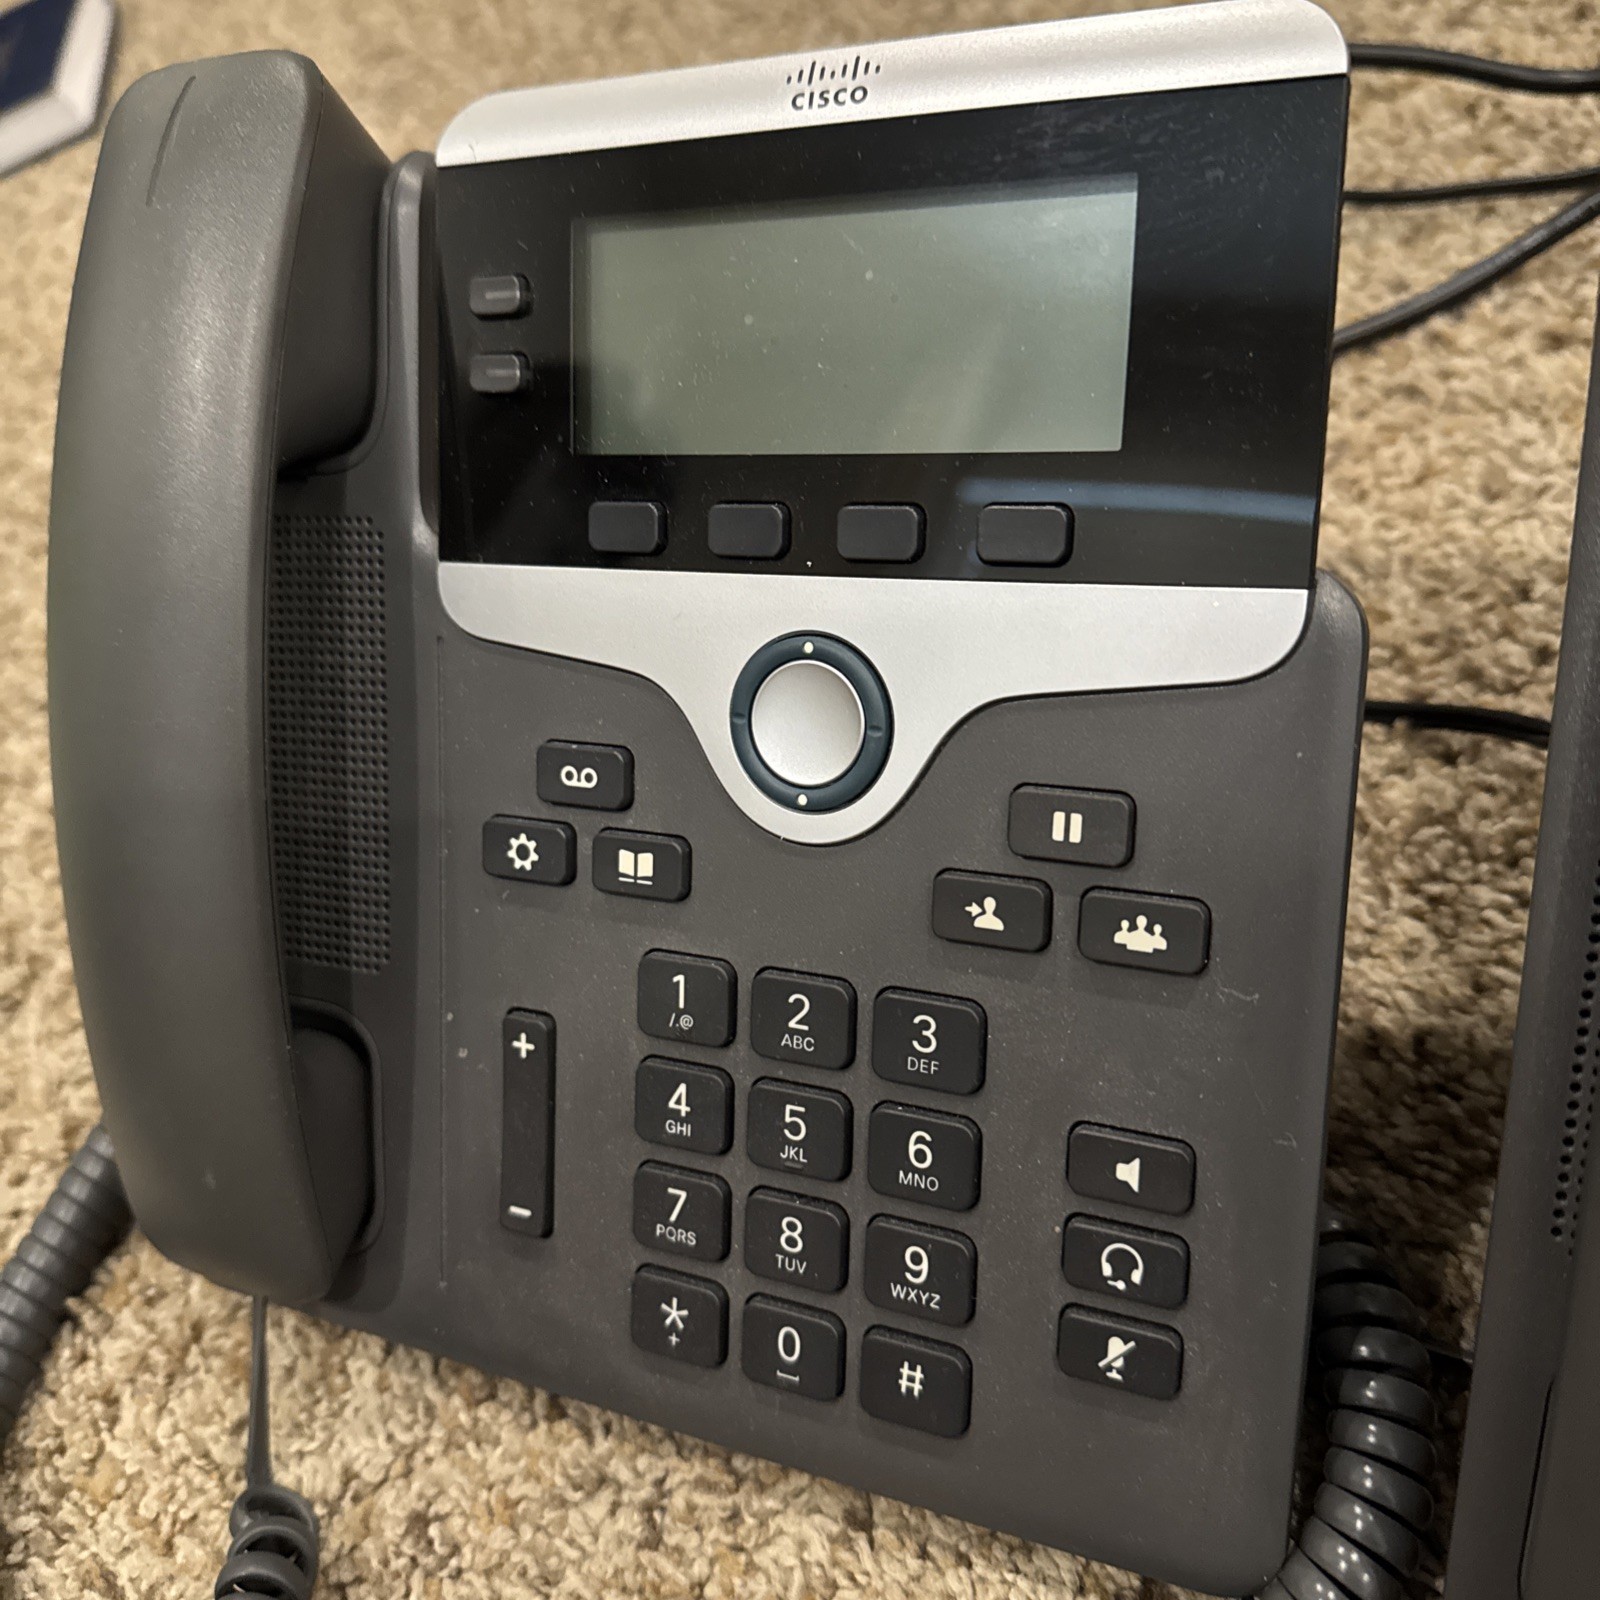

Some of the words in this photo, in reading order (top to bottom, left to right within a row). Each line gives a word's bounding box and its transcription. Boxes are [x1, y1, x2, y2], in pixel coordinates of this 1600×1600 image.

[791, 85, 868, 111] CISCO
[673, 974, 686, 1010] 1
[787, 993, 811, 1031] 2
[780, 1033, 815, 1052] ABC
[911, 1014, 938, 1054] 3
[907, 1056, 940, 1076] DEF
[667, 1082, 691, 1118] 4
[665, 1119, 692, 1138] GHI
[783, 1103, 808, 1142] 5
[779, 1144, 809, 1164] JKL
[908, 1130, 934, 1170] 6
[898, 1169, 940, 1192] MNO
[667, 1187, 688, 1223] 7
[655, 1223, 697, 1246] PQRS
[779, 1216, 804, 1254] 8
[775, 1253, 807, 1275] TUV
[904, 1245, 930, 1285] 9
[890, 1282, 942, 1310] WXYZ
[777, 1326, 801, 1364] 0
[898, 1360, 925, 1399] #
